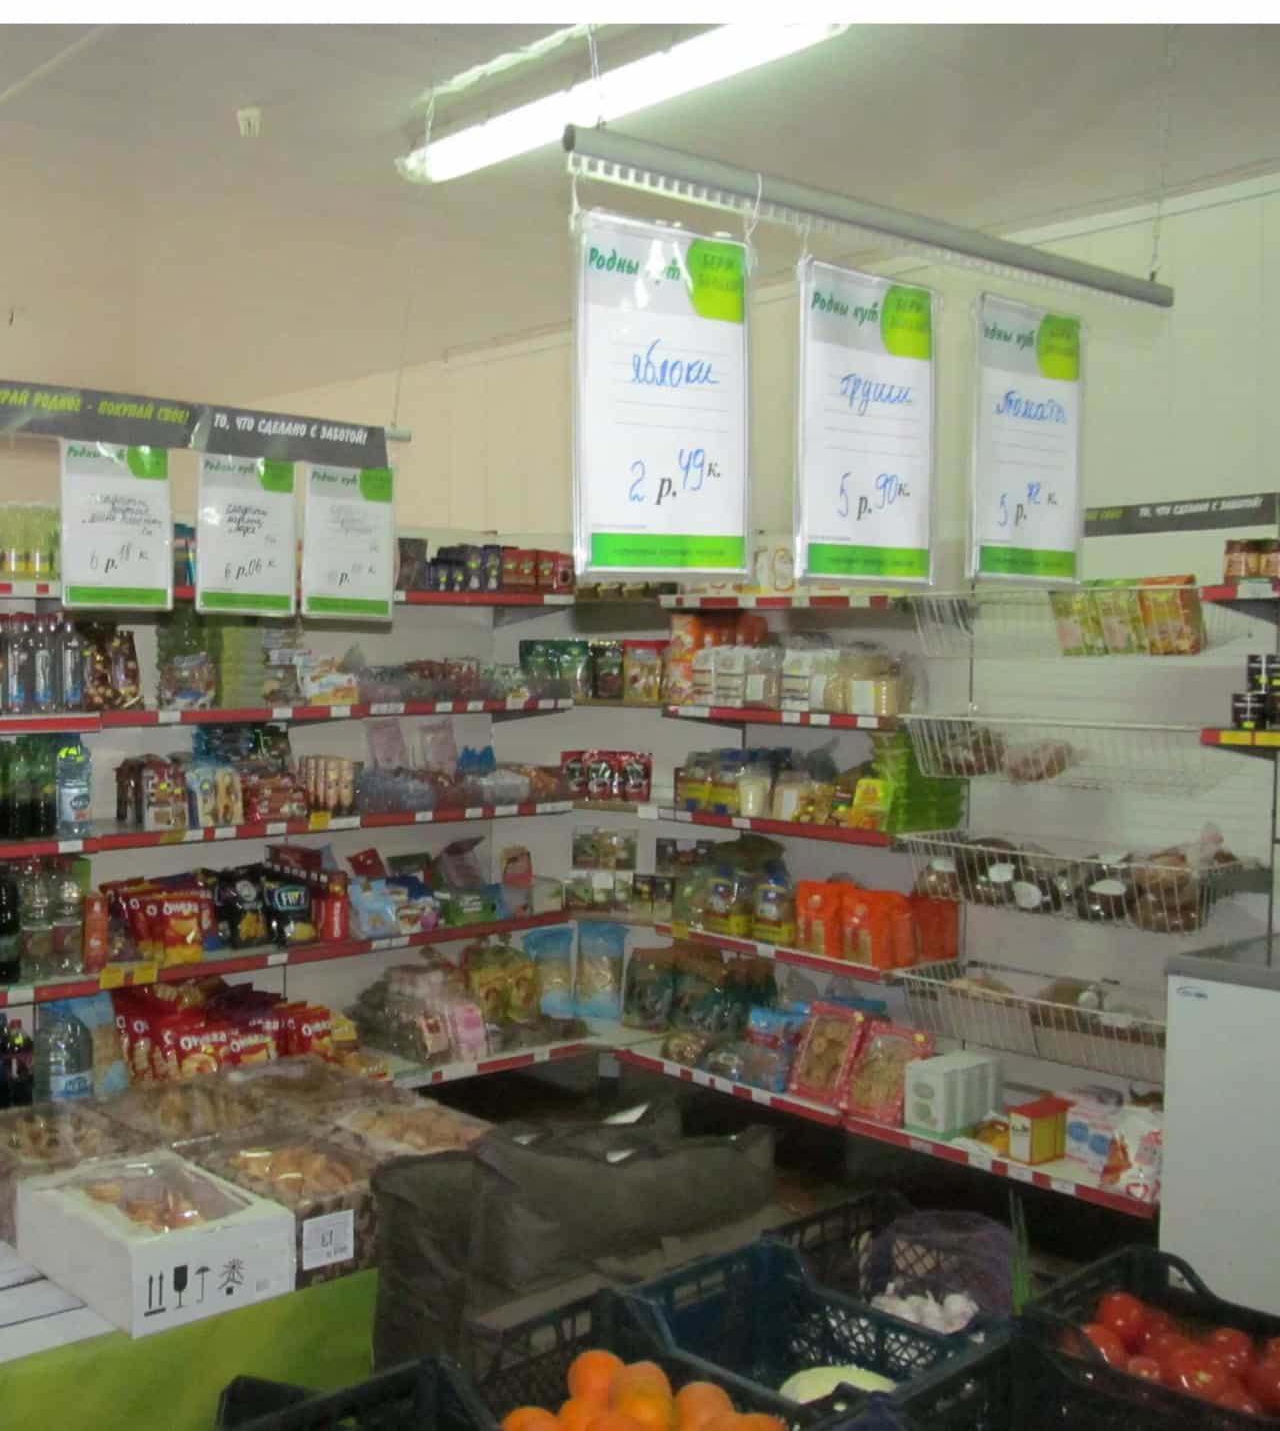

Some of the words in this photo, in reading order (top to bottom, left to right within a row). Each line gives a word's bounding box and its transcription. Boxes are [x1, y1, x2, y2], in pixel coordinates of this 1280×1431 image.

[589, 247, 639, 276] Родны
[811, 291, 849, 316] Родны
[632, 338, 720, 387] яблоки
[32, 391, 82, 413] РОДНОЕ
[97, 400, 154, 420] ПОКУПАЙ
[214, 413, 231, 430] ТО,
[236, 416, 255, 432] ЧТО
[257, 418, 307, 437] СДЕЛАНО
[310, 423, 318, 438] С
[319, 426, 369, 446] ЗАБОТОЙ!
[628, 460, 646, 503] 2
[678, 448, 706, 491] 49
